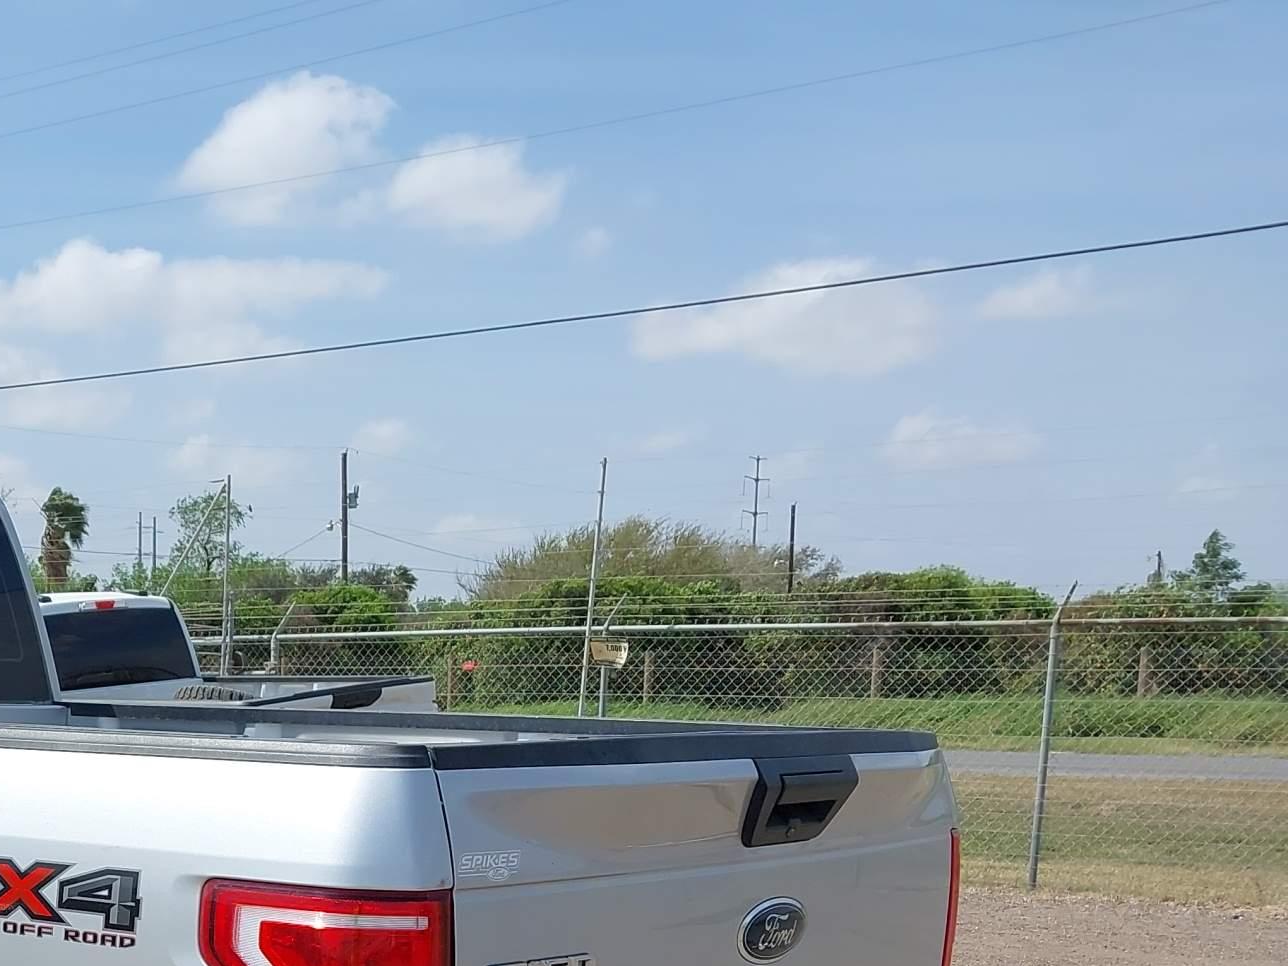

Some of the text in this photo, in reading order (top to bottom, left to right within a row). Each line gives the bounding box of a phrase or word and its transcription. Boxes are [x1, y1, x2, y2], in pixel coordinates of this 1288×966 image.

[460, 852, 520, 869] SPIKES
[2, 920, 137, 949] OFF ROAD
[753, 913, 799, 951] Ford
